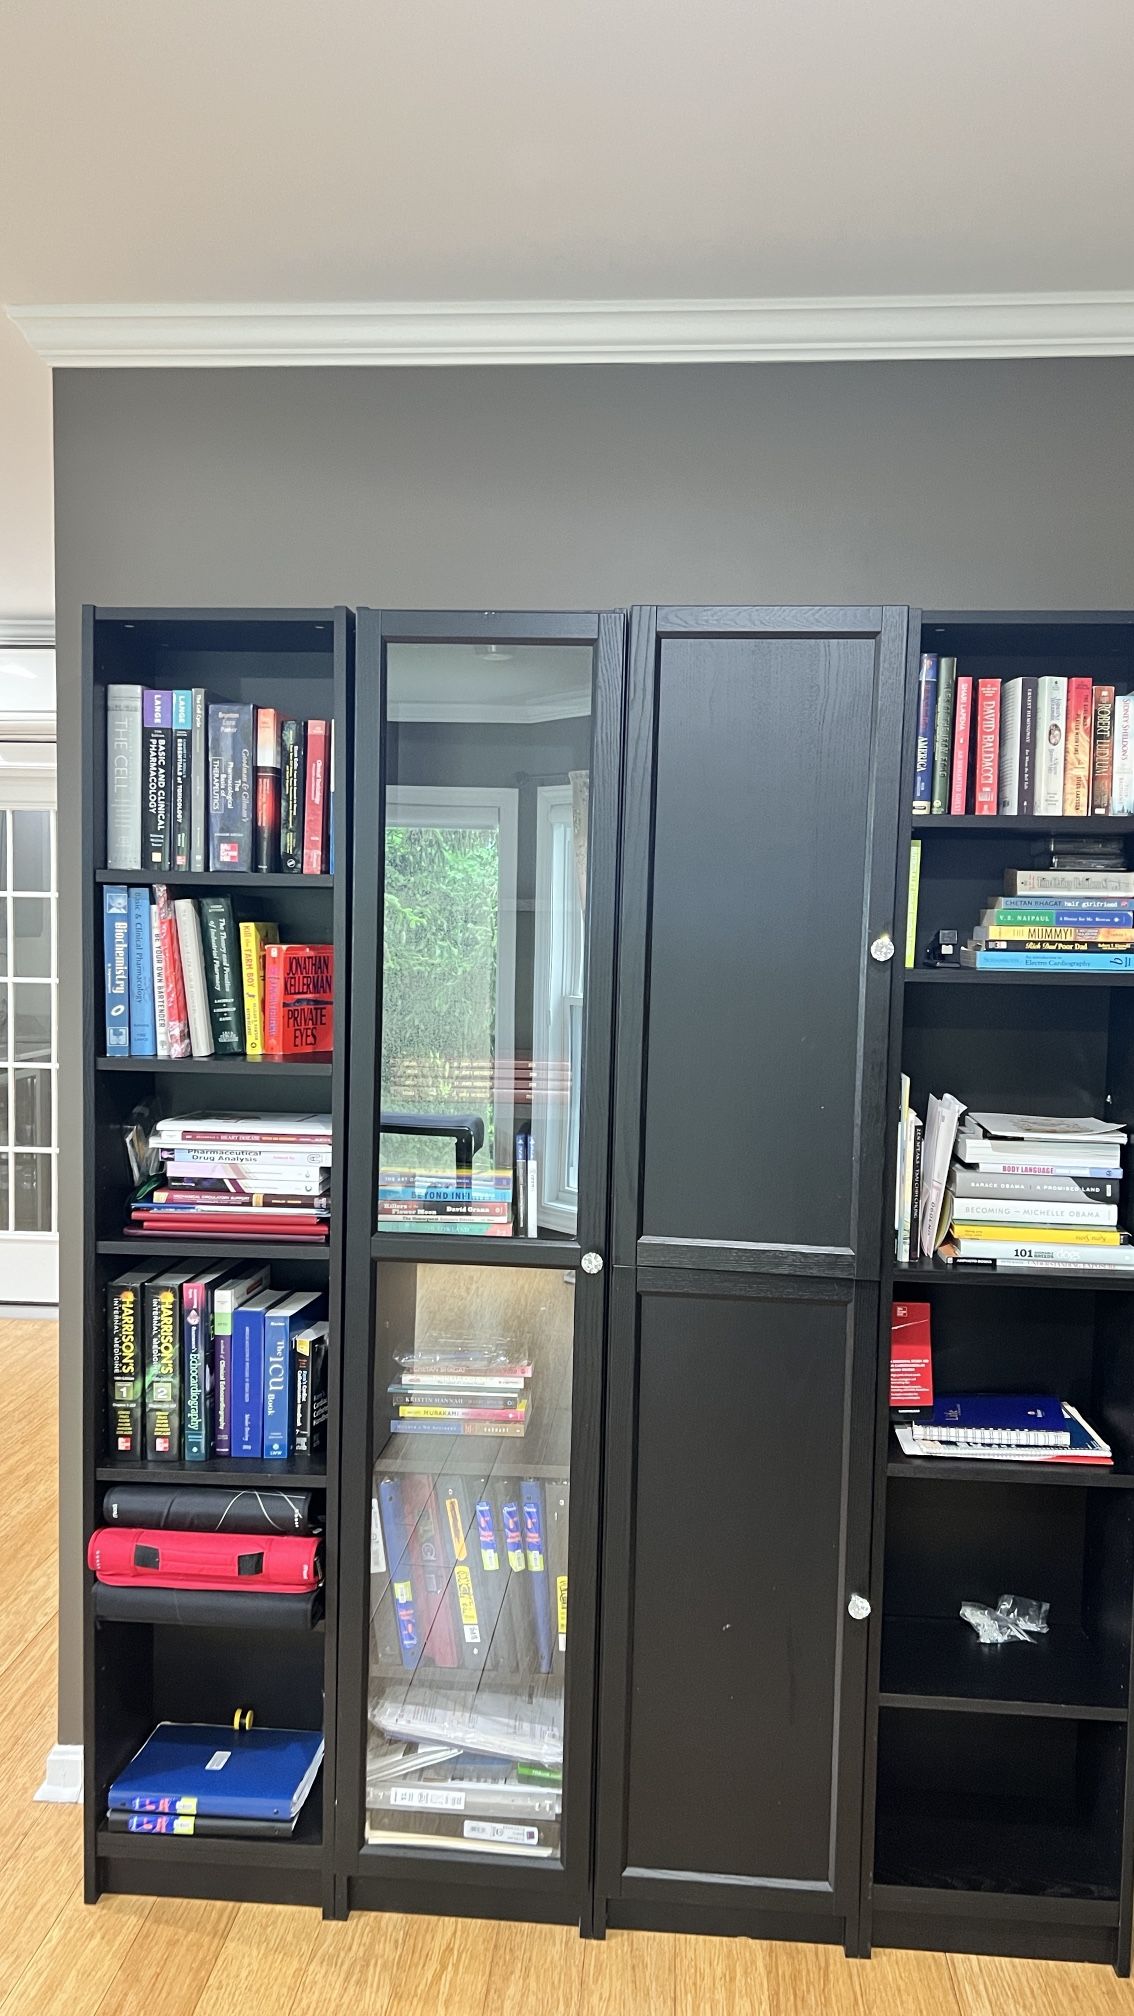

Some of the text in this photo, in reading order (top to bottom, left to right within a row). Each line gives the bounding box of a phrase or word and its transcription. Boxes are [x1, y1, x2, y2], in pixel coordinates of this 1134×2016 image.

[154, 695, 162, 724] LANGE
[178, 695, 186, 724] LANGE
[959, 683, 969, 731] SHARI LAPENA
[981, 701, 996, 784] DAVID BALDACCI
[1095, 704, 1112, 776] ROBERT LUDLUM
[1120, 699, 1131, 761] SIDNEY SHELDON'S
[114, 717, 128, 793] THE CELL
[158, 739, 166, 766] BASIC
[916, 735, 929, 772] AMERICA
[148, 739, 158, 814] PHARMACOLOGY
[157, 787, 166, 831] CLINICAL
[135, 922, 144, 951] Clinical
[154, 933, 161, 943] BE
[208, 920, 217, 928] of
[1027, 928, 1072, 940] MUMMY!
[219, 931, 228, 953] Theory
[112, 922, 128, 994] Biochemistry
[287, 956, 330, 976] JONATHAN
[1048, 959, 1091, 968] Cardiography
[135, 952, 145, 1004] Pharmacology
[247, 973, 255, 988] BOY
[284, 975, 332, 996] KELLERMAN
[157, 985, 166, 1028] BARTENDER
[287, 1007, 326, 1028] PRIVATE
[294, 1027, 317, 1048] EYES
[187, 1148, 262, 1157] Pharmaceutical
[192, 1154, 258, 1163] Drug Analysis
[1002, 1164, 1054, 1174] BODY LANGUAGE
[411, 1191, 448, 1200] BEYOND
[446, 1205, 467, 1213] David
[965, 1206, 1101, 1219] BECOMING MICHELLE OBAMA
[1013, 1248, 1034, 1259] 101
[152, 1298, 160, 1336] INTERNAL
[113, 1298, 121, 1375] INTERNAL MEDICINE
[121, 1300, 134, 1375] HARRISON'S
[160, 1299, 174, 1375] HARRISON'S
[119, 1386, 128, 1398] 1
[188, 1352, 200, 1430] Echocardiography
[267, 1341, 285, 1416] The ICU Book
[157, 1387, 166, 1399] 2
